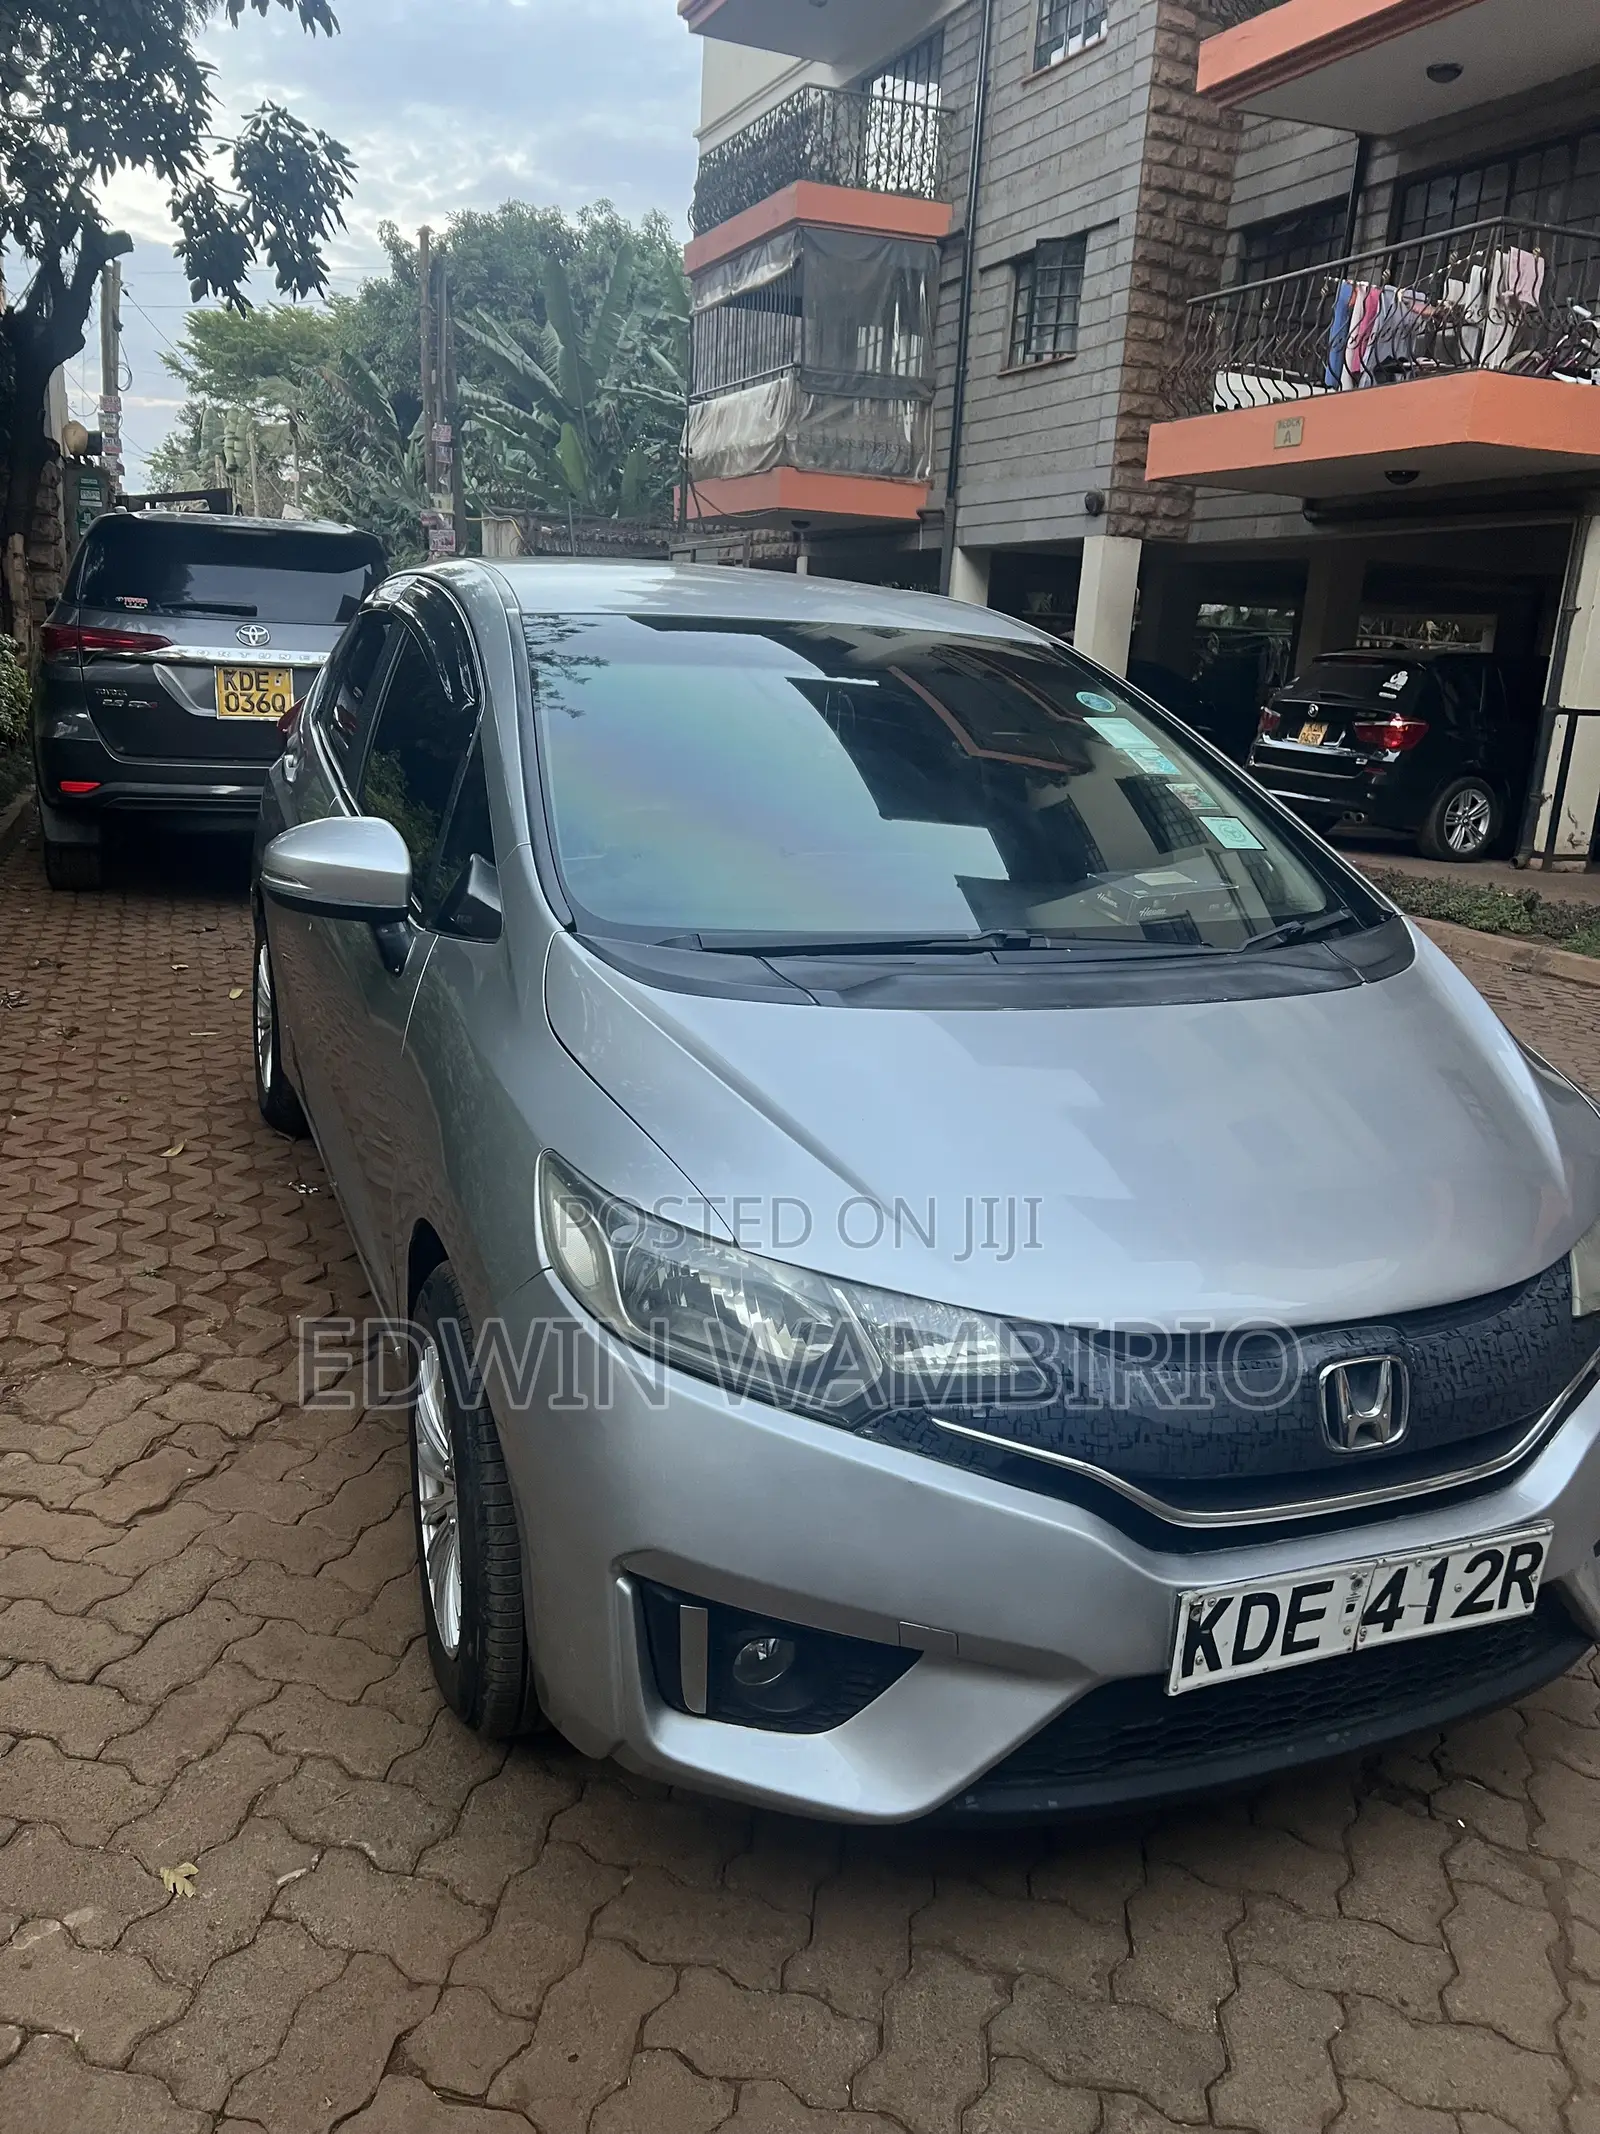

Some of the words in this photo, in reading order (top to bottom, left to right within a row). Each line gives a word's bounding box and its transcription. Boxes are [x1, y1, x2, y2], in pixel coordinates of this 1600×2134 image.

[1278, 418, 1300, 429] BLOCK
[1284, 430, 1291, 444] A
[223, 669, 269, 692] KDE
[225, 692, 286, 713] 036Q
[1181, 1580, 1335, 1678] KDE
[1359, 1542, 1544, 1633] 412R
